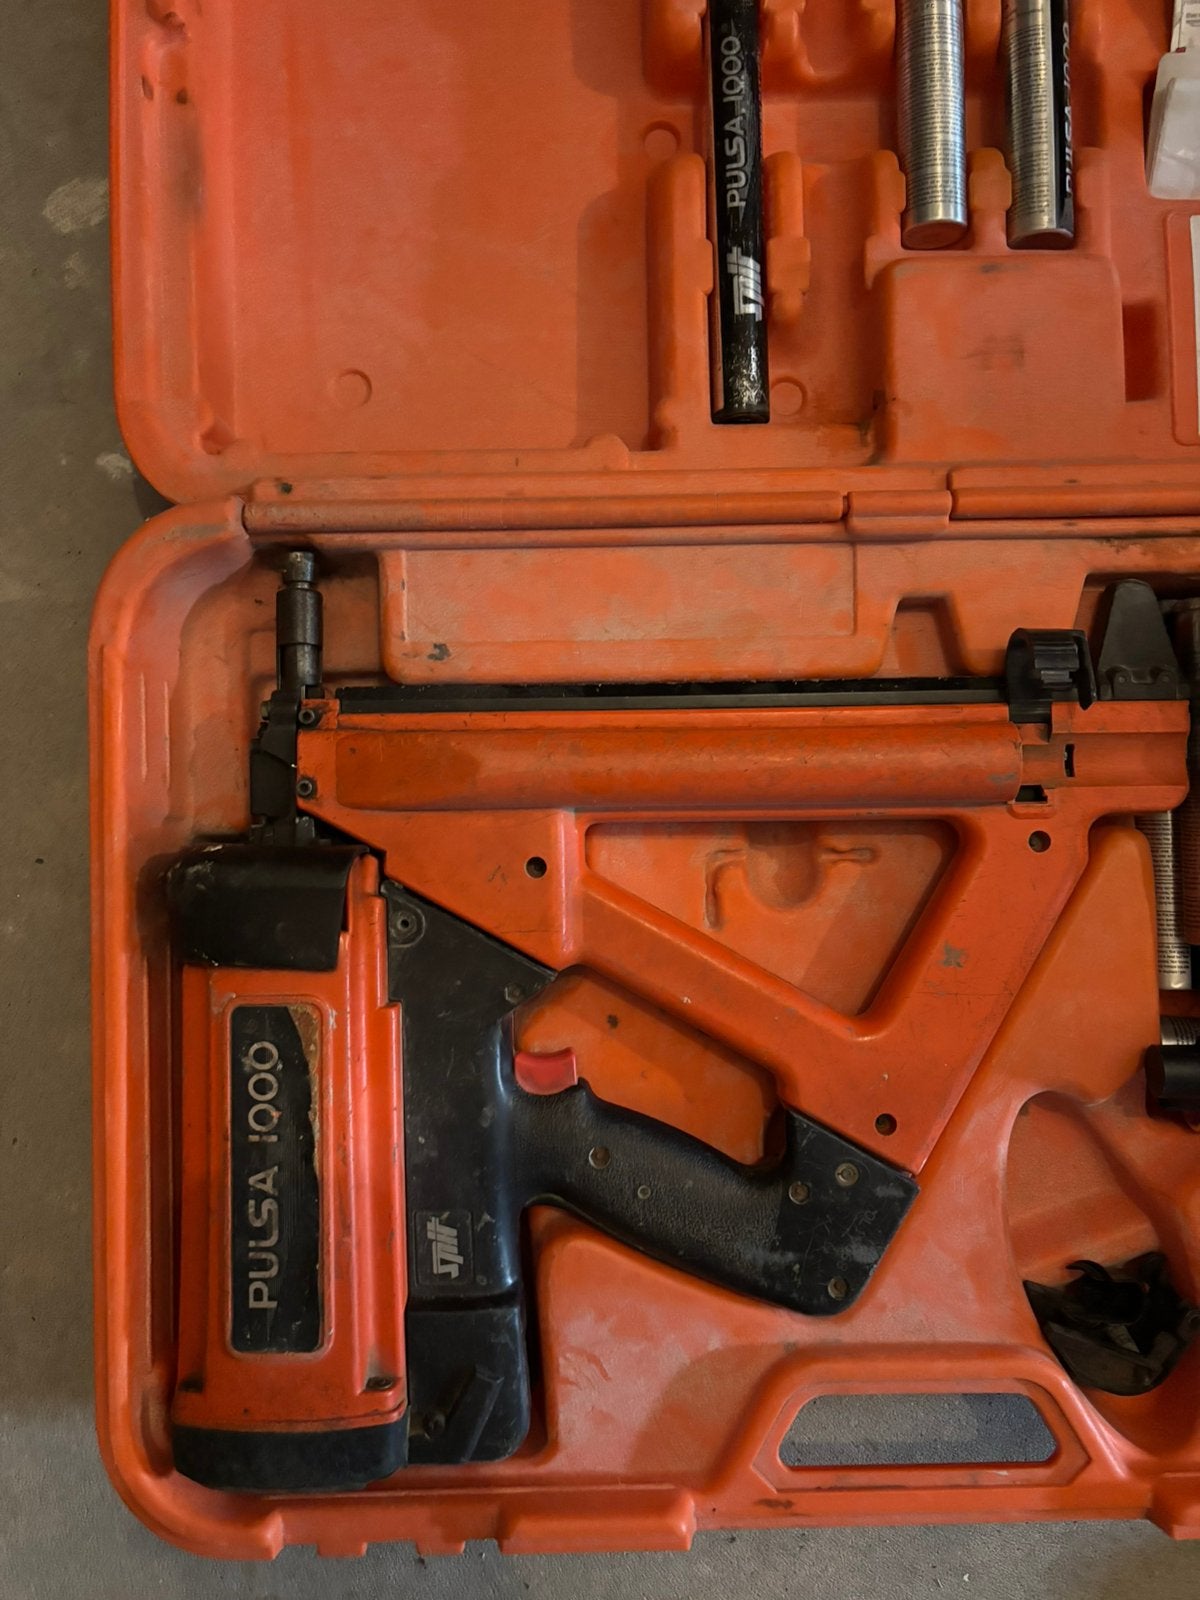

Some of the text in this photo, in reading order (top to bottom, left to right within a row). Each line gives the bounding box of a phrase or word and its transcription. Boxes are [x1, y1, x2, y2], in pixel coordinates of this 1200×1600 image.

[721, 35, 747, 208] PULSA 1000
[247, 1040, 280, 1310] PULSA 1000
